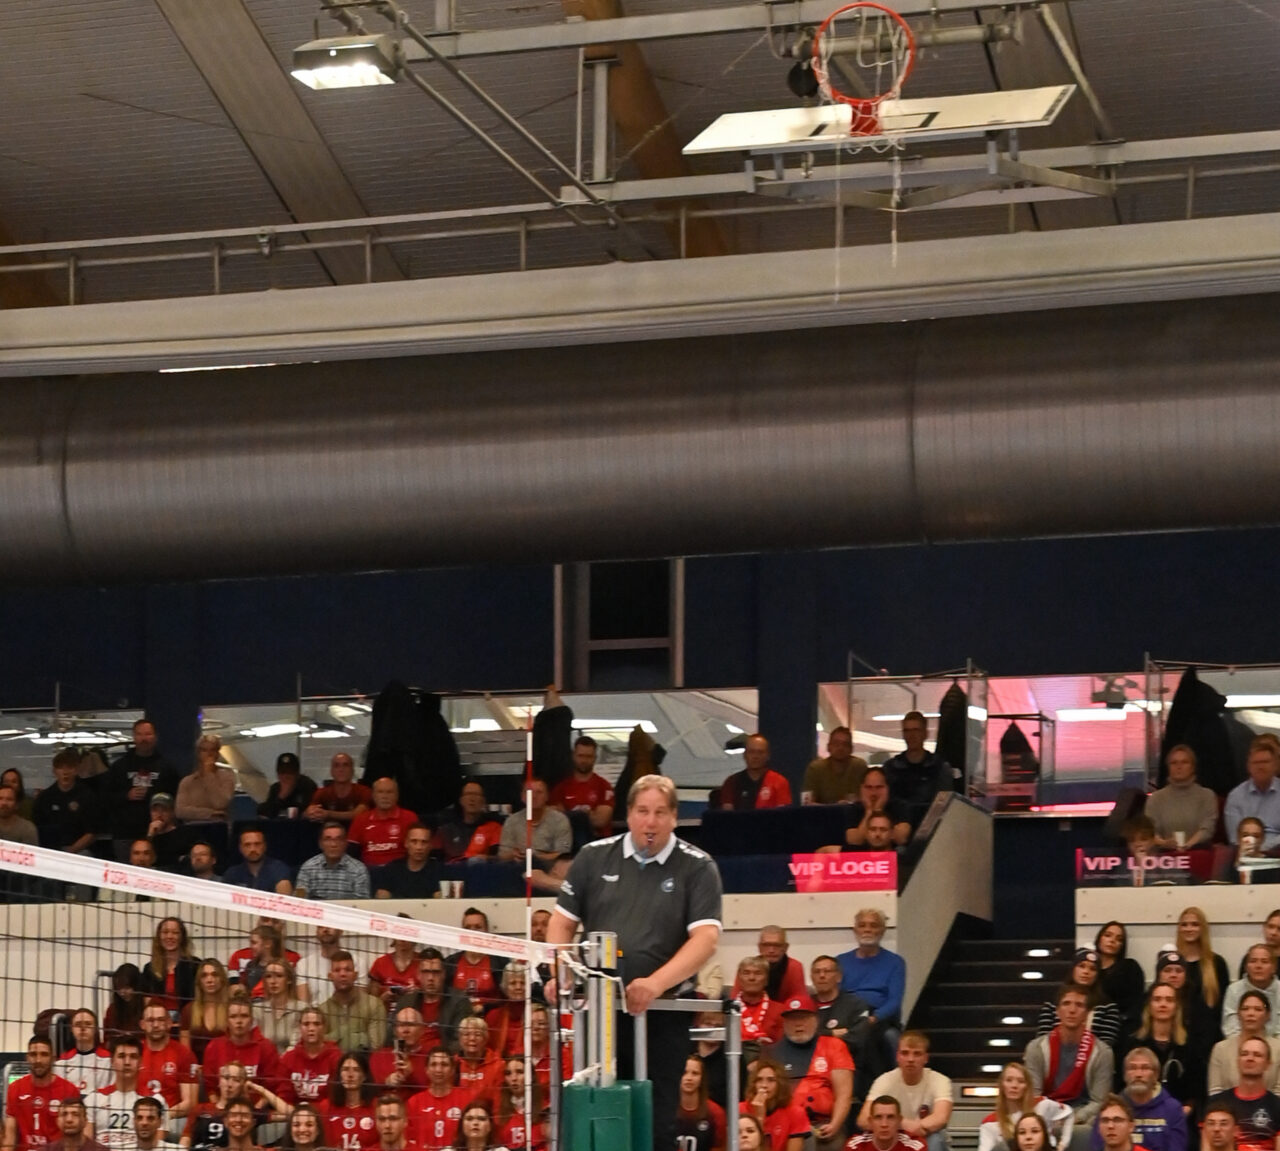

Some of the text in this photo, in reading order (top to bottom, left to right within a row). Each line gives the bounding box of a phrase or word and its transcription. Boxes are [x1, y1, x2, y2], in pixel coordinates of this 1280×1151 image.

[788, 860, 890, 876] VIP LOGE
[1083, 855, 1191, 871] VIP LOGE
[109, 1113, 130, 1130] 22
[434, 1120, 445, 1137] 8
[208, 1122, 223, 1139] 9
[510, 1126, 525, 1144] 15
[341, 1133, 361, 1149] 14
